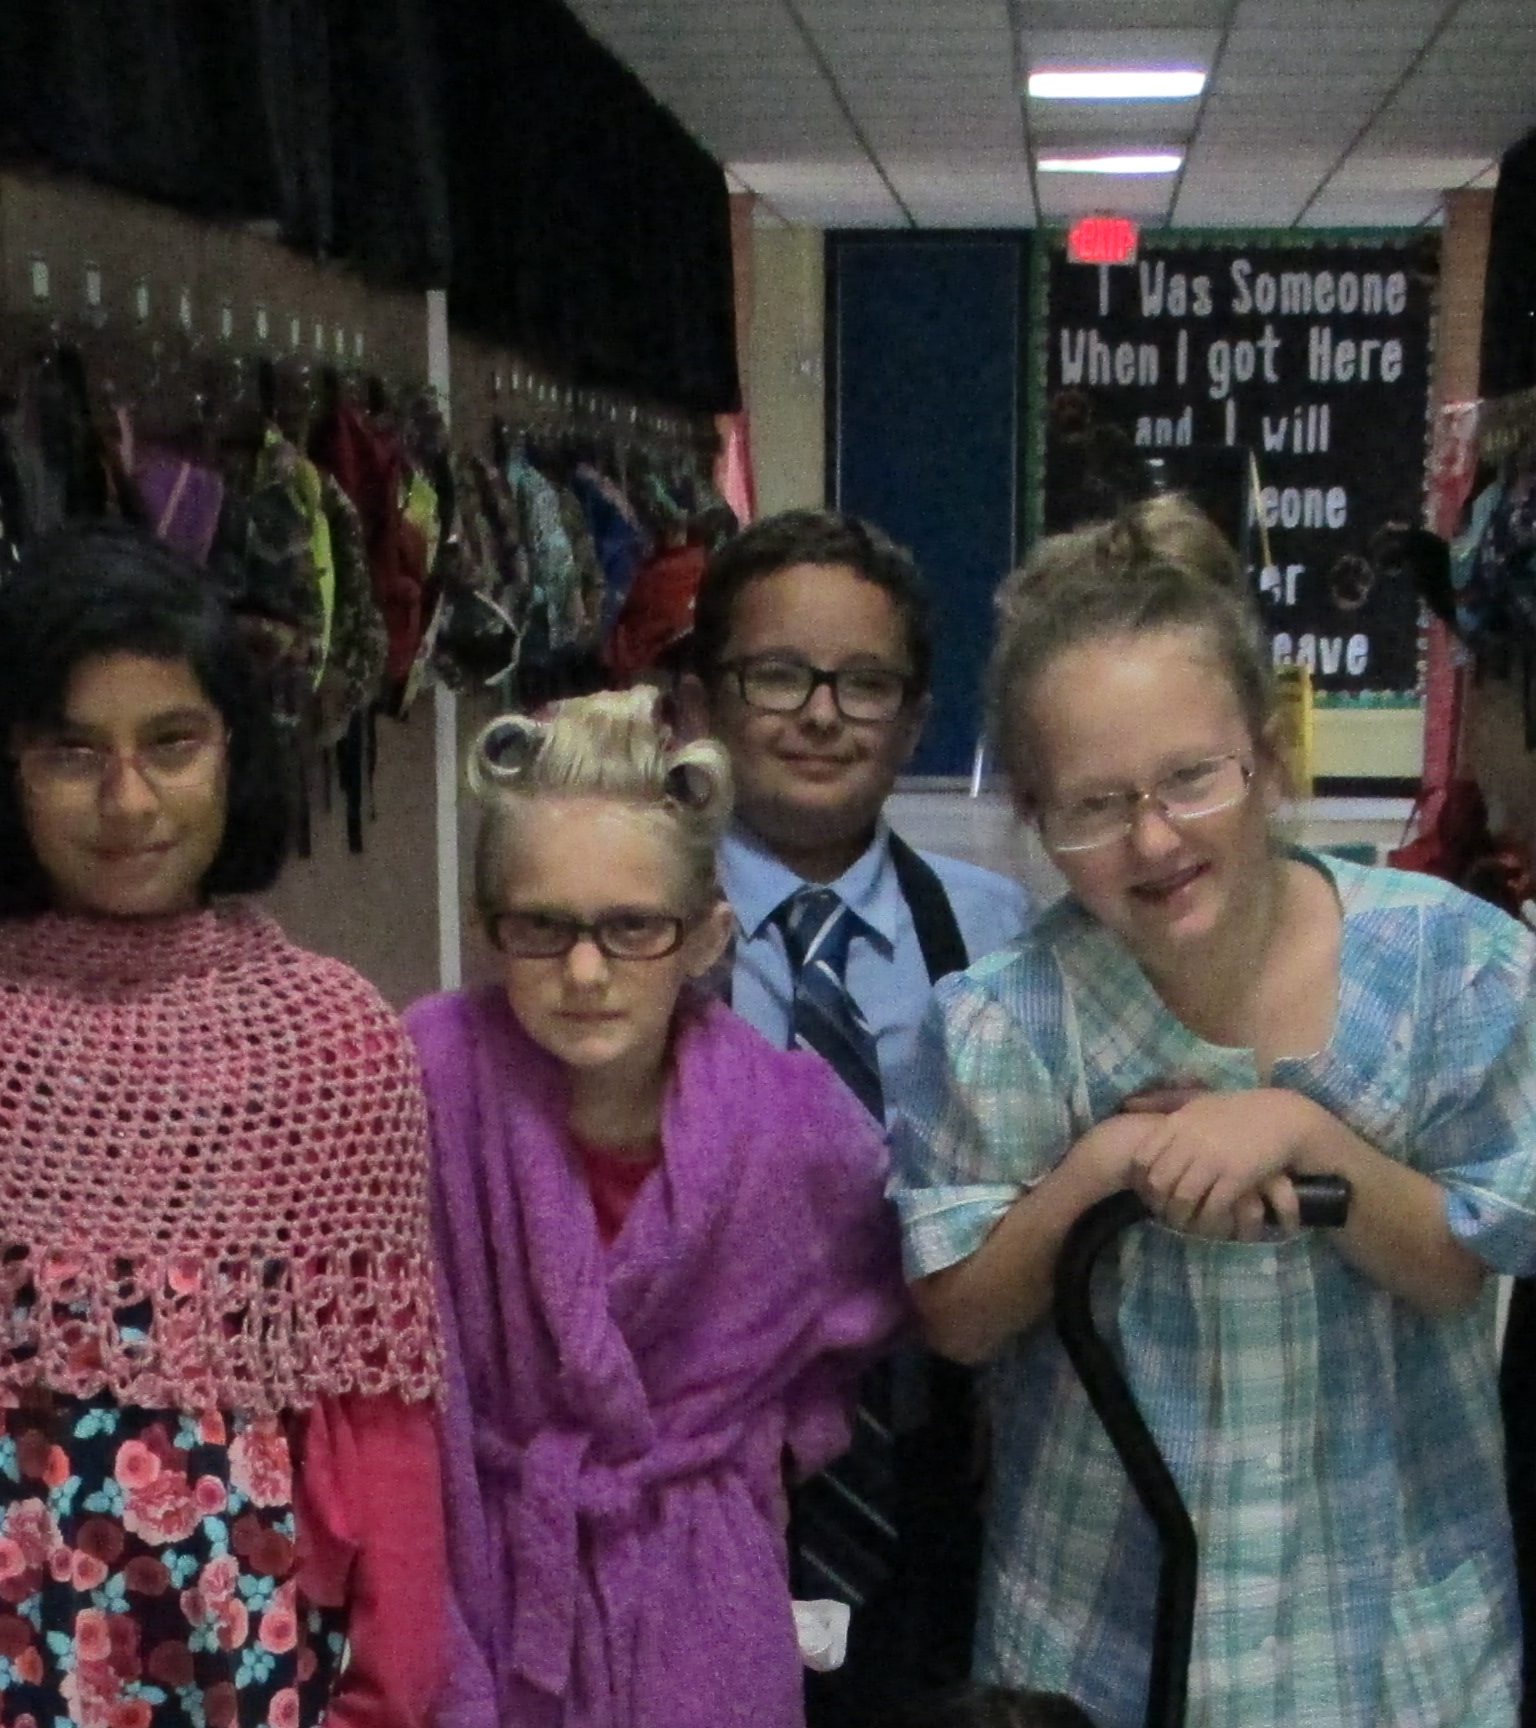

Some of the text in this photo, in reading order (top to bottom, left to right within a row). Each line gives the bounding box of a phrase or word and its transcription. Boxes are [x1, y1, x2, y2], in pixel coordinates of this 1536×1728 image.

[1139, 260, 1212, 317] Was
[1231, 258, 1407, 315] Someone
[1061, 324, 1403, 399] When I got Here
[1135, 398, 1330, 453] and I will
[1272, 632, 1369, 675] eave
